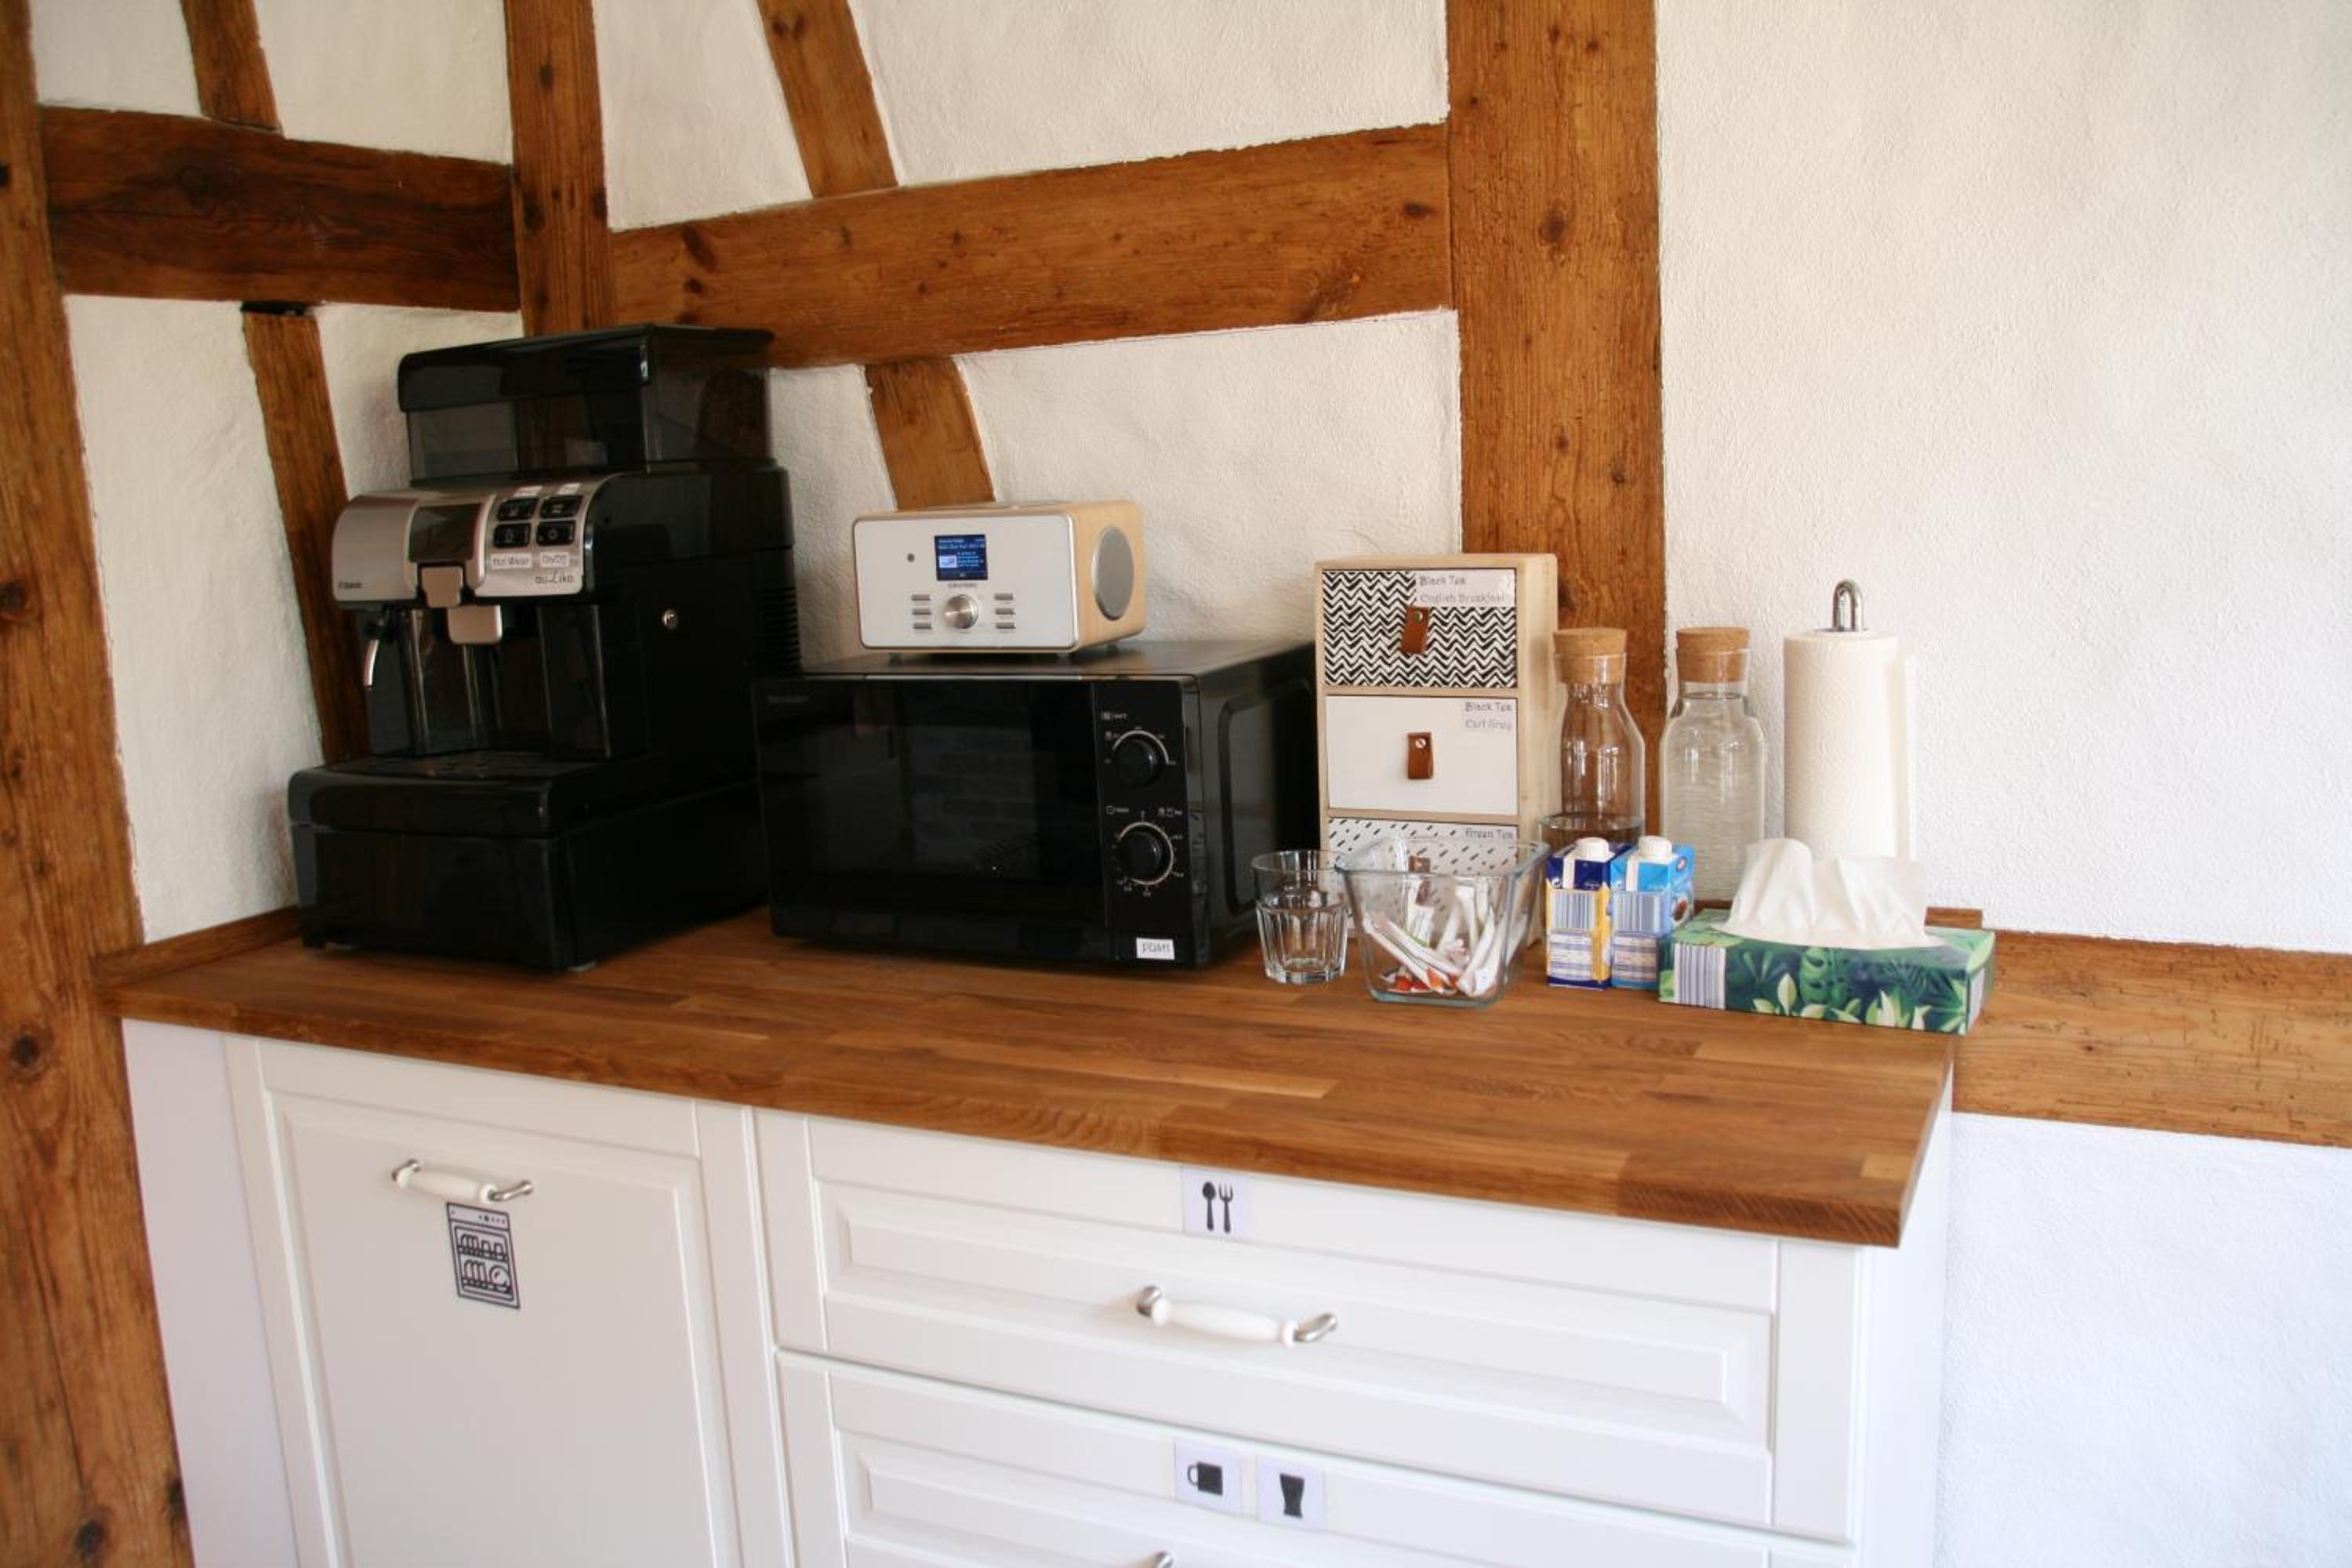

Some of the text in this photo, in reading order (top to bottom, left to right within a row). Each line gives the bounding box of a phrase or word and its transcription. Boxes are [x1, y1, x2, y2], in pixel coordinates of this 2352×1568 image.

[1420, 575, 1466, 586] Black Tea
[1465, 702, 1512, 712] Black Tea
